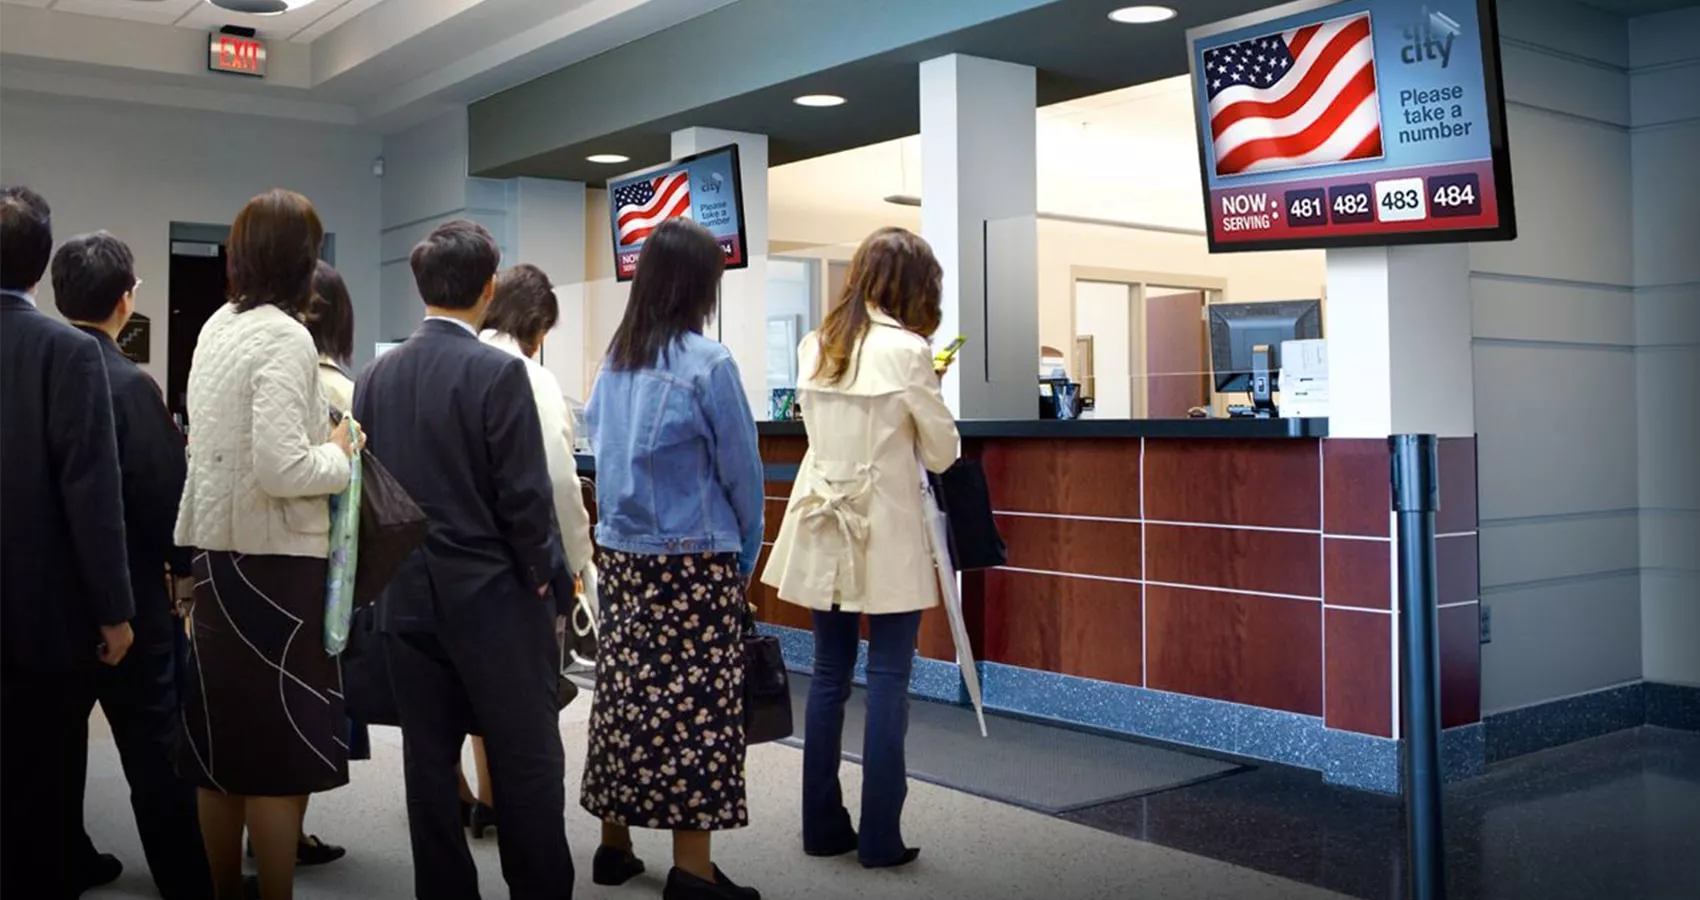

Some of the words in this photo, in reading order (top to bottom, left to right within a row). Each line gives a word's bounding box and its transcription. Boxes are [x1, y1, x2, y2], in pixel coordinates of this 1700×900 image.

[219, 37, 262, 71] EXIT
[1401, 31, 1454, 68] city
[1400, 85, 1463, 107] Please
[1404, 106, 1445, 125] take
[1451, 104, 1462, 118] a
[1399, 121, 1472, 143] number
[1221, 193, 1267, 215] NOW
[1290, 198, 1321, 218] 481
[1333, 194, 1369, 214] 482
[1381, 189, 1419, 210] 483
[1433, 184, 1475, 206] 484
[1223, 214, 1271, 231] SERVING
